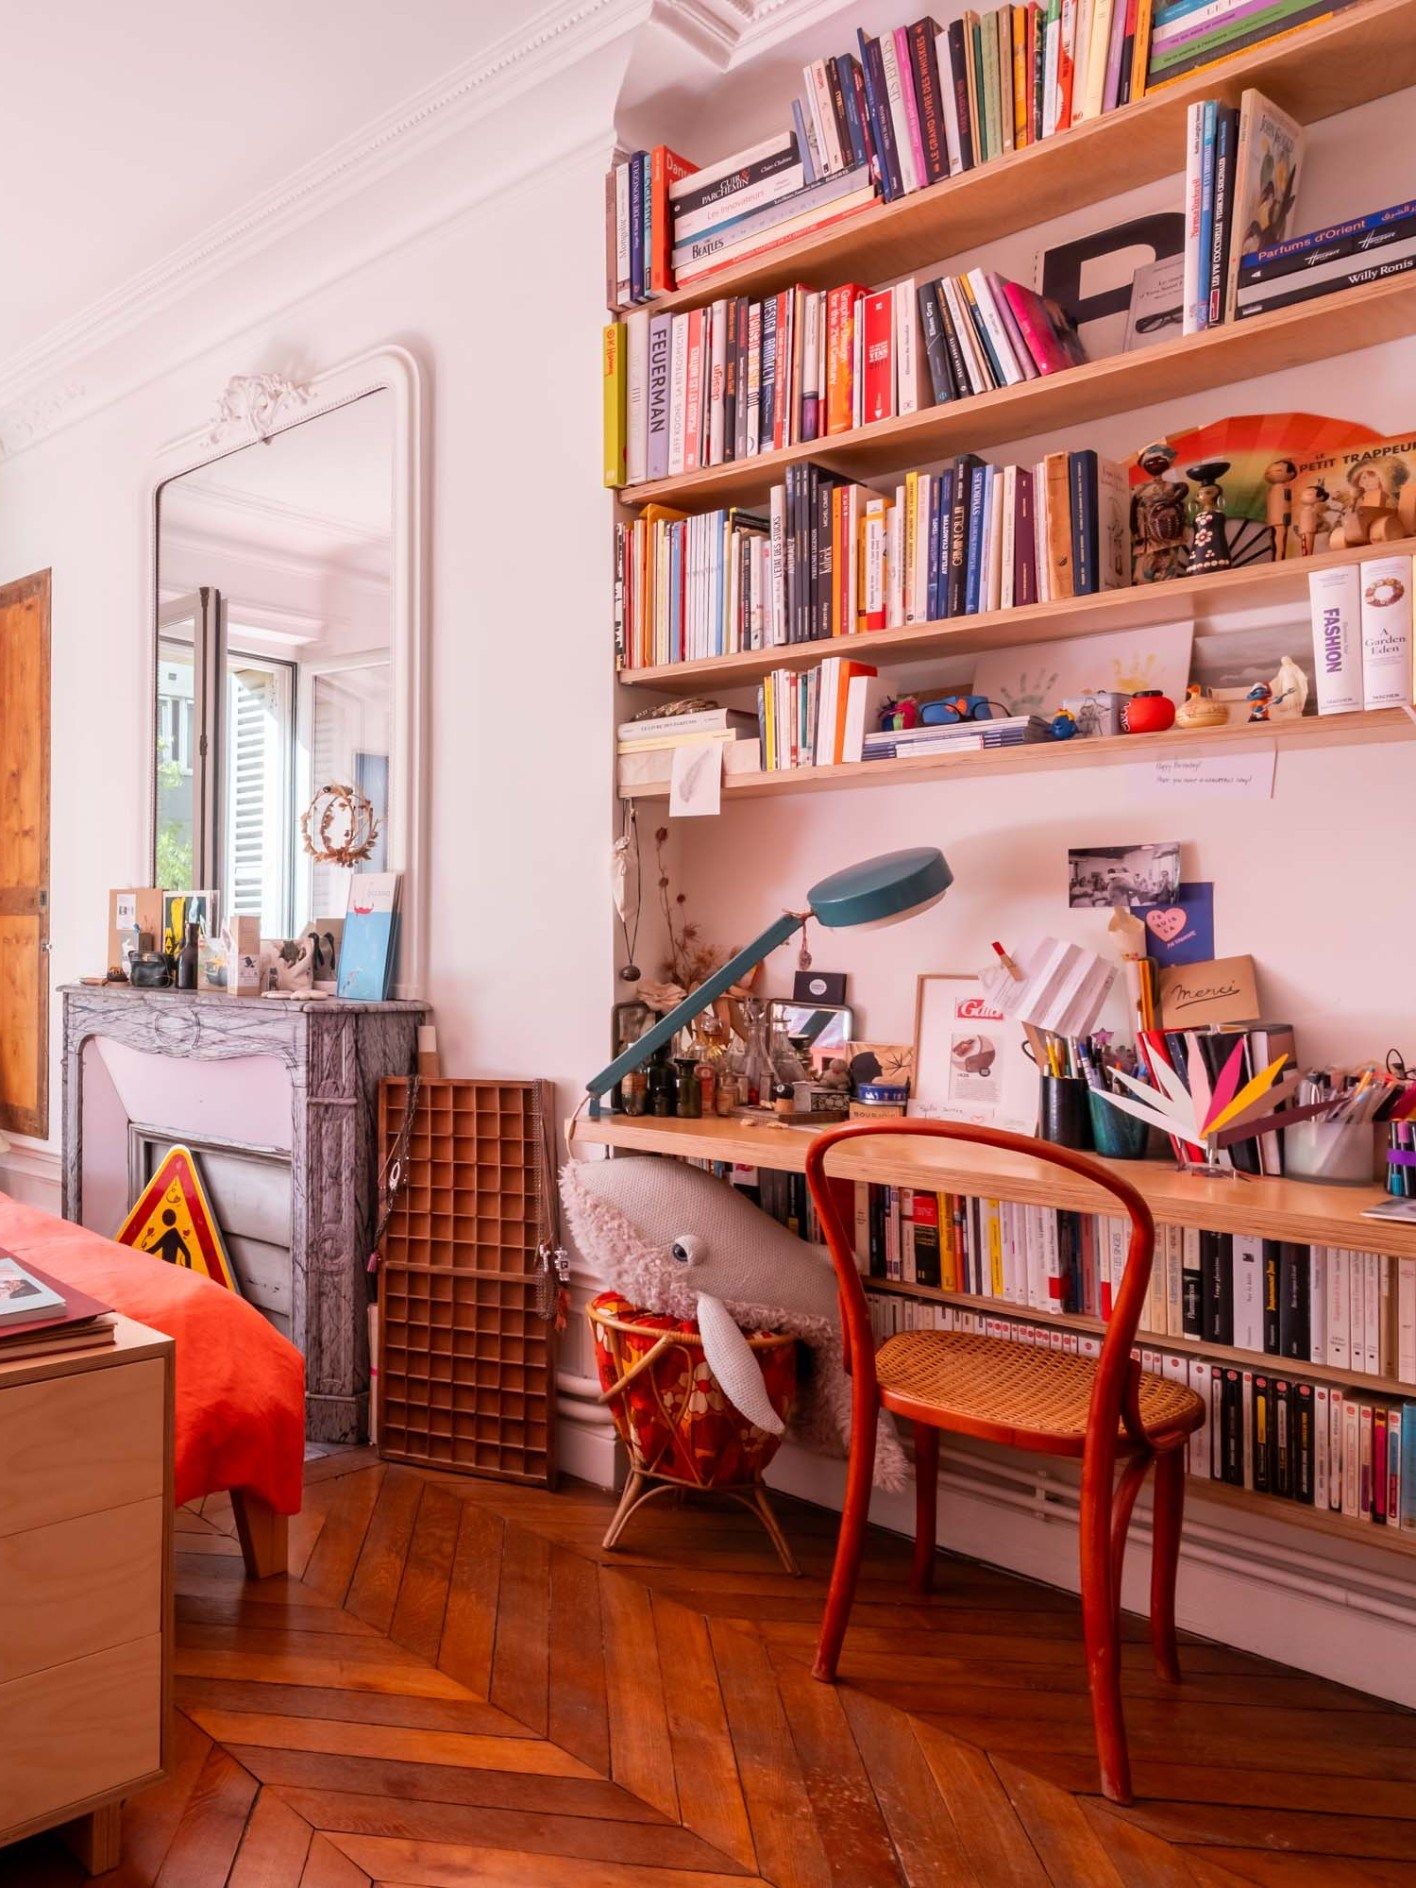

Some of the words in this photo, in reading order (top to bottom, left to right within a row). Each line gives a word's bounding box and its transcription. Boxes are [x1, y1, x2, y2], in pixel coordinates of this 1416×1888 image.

[918, 36, 929, 75] WHISKIES
[922, 76, 932, 95] DES
[924, 96, 934, 115] LIVRE
[926, 117, 937, 150] GRAND
[930, 150, 939, 162] LE
[692, 239, 725, 260] BEATLES
[1258, 237, 1311, 263] Parfums
[1314, 219, 1367, 244] d'Orient
[1348, 266, 1380, 286] Willy
[1380, 257, 1415, 277] Ronis
[764, 299, 776, 333] DESIGN
[841, 289, 850, 326] Graphic
[926, 301, 935, 318] Gray
[840, 328, 849, 363] Design
[763, 338, 776, 385] BROOKLYN
[650, 329, 669, 434] FEUERMAN
[1298, 457, 1336, 474] PETIT
[972, 472, 983, 516] SYMBOLES
[773, 516, 781, 541] STOCKS
[819, 546, 832, 574] Kubrick
[1323, 607, 1343, 673] FASHION
[1364, 634, 1407, 648] Garden
